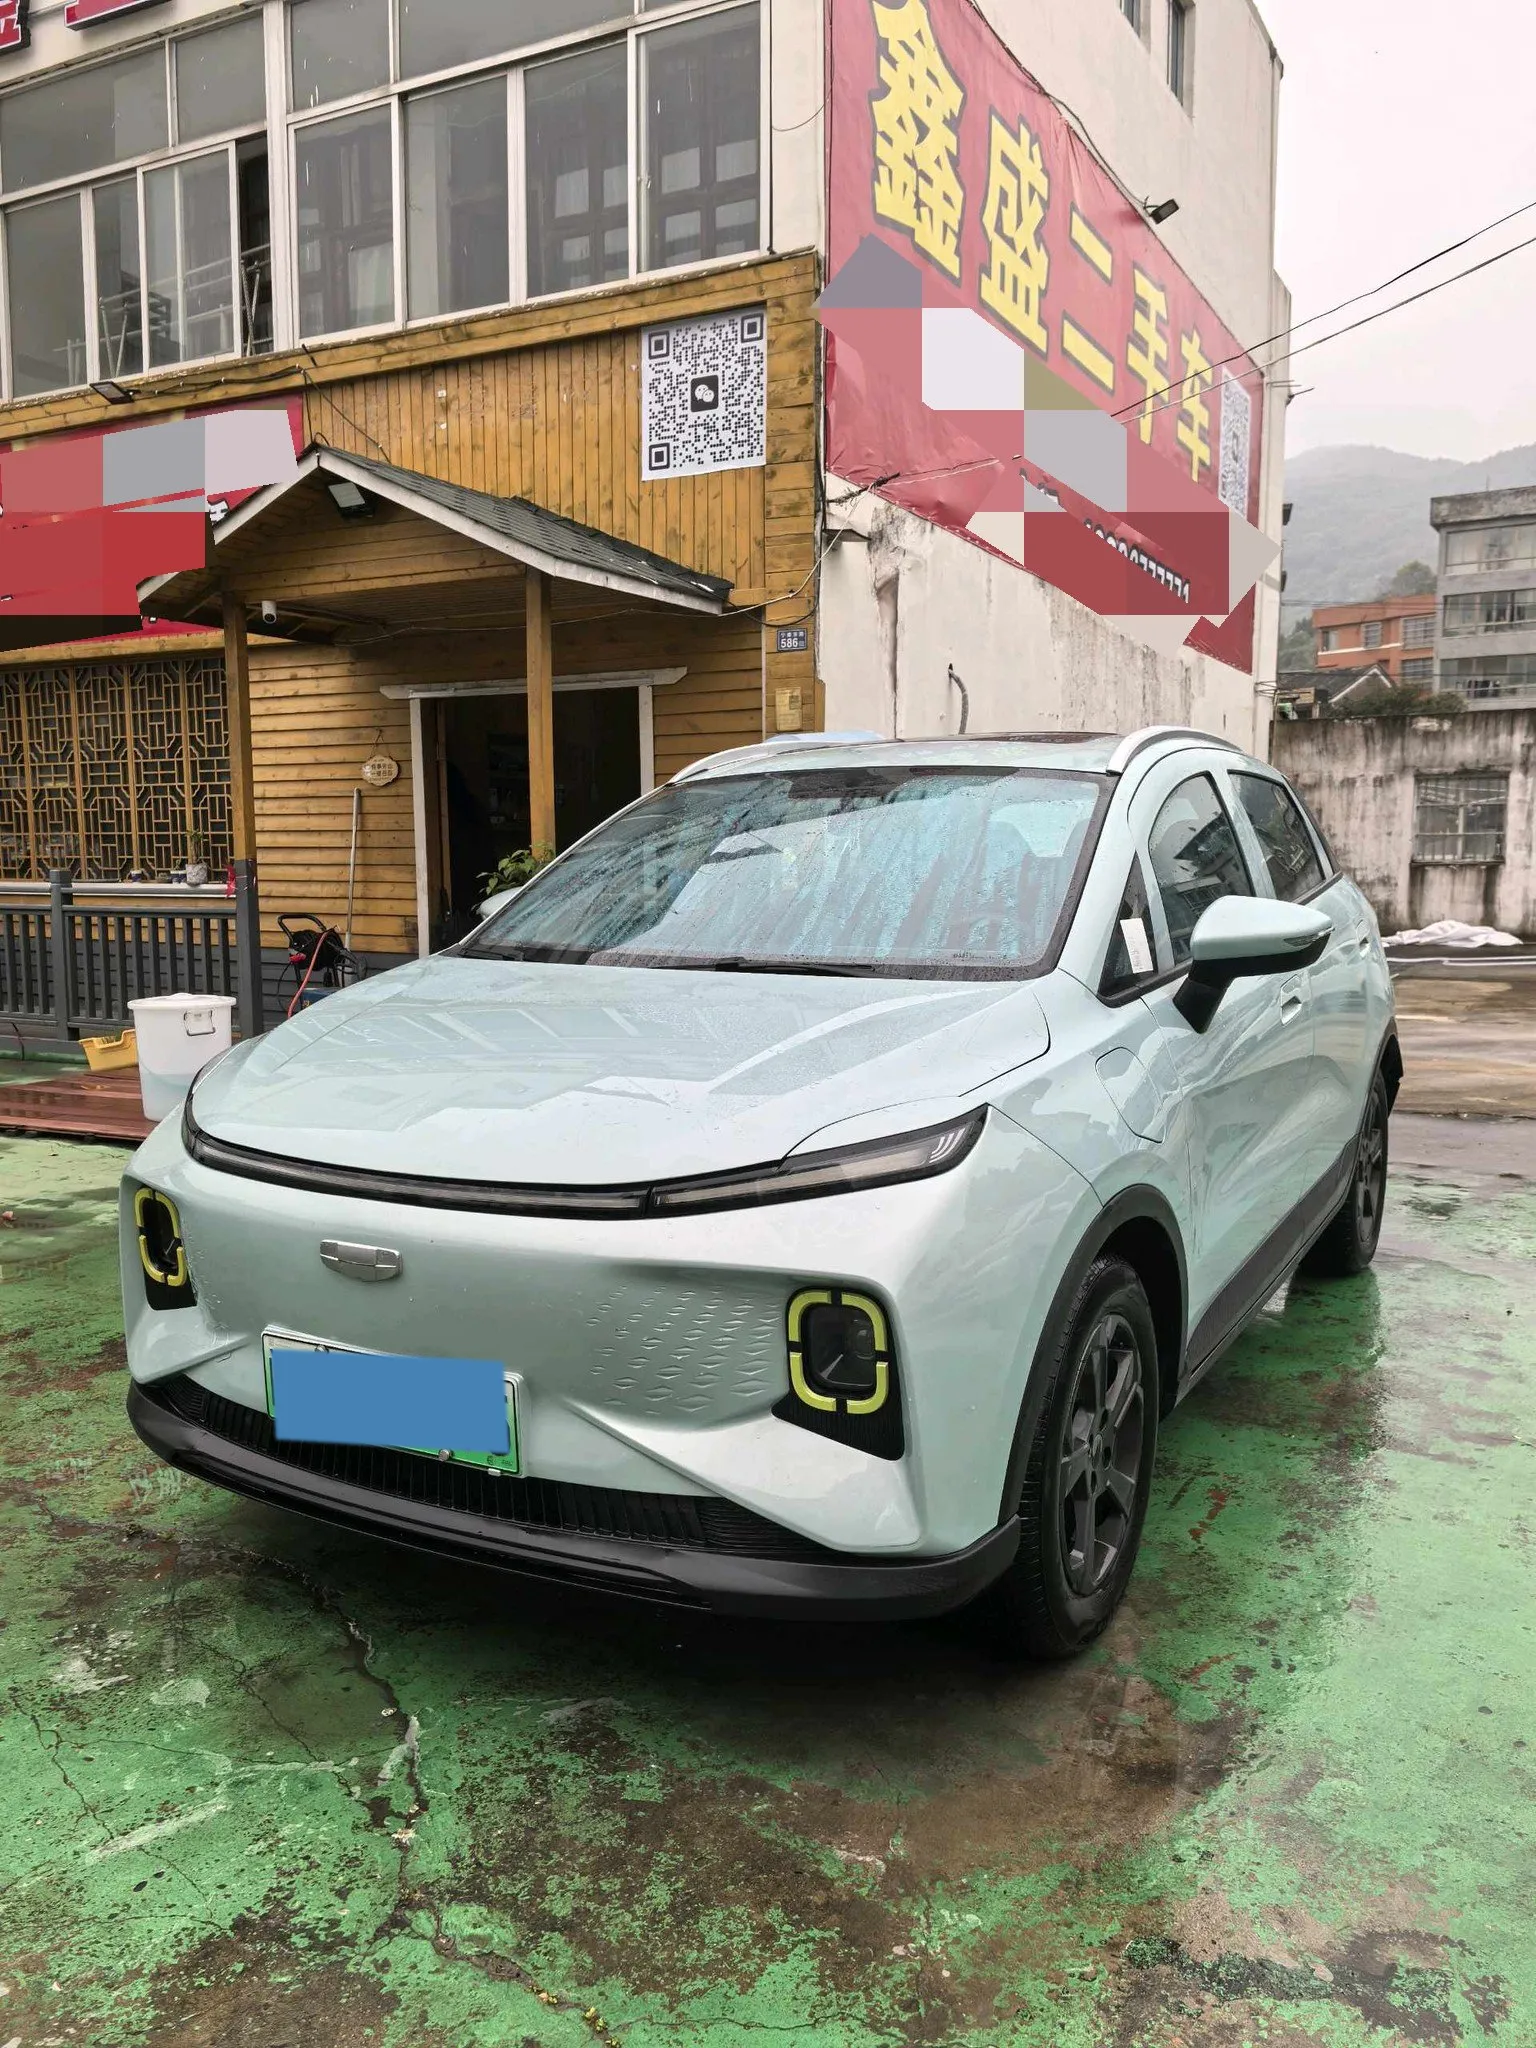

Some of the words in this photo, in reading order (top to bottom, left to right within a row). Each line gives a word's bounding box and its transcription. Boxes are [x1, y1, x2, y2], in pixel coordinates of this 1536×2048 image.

[871, 0, 1213, 482] 鑫盛二手车
[781, 638, 804, 648] 586
